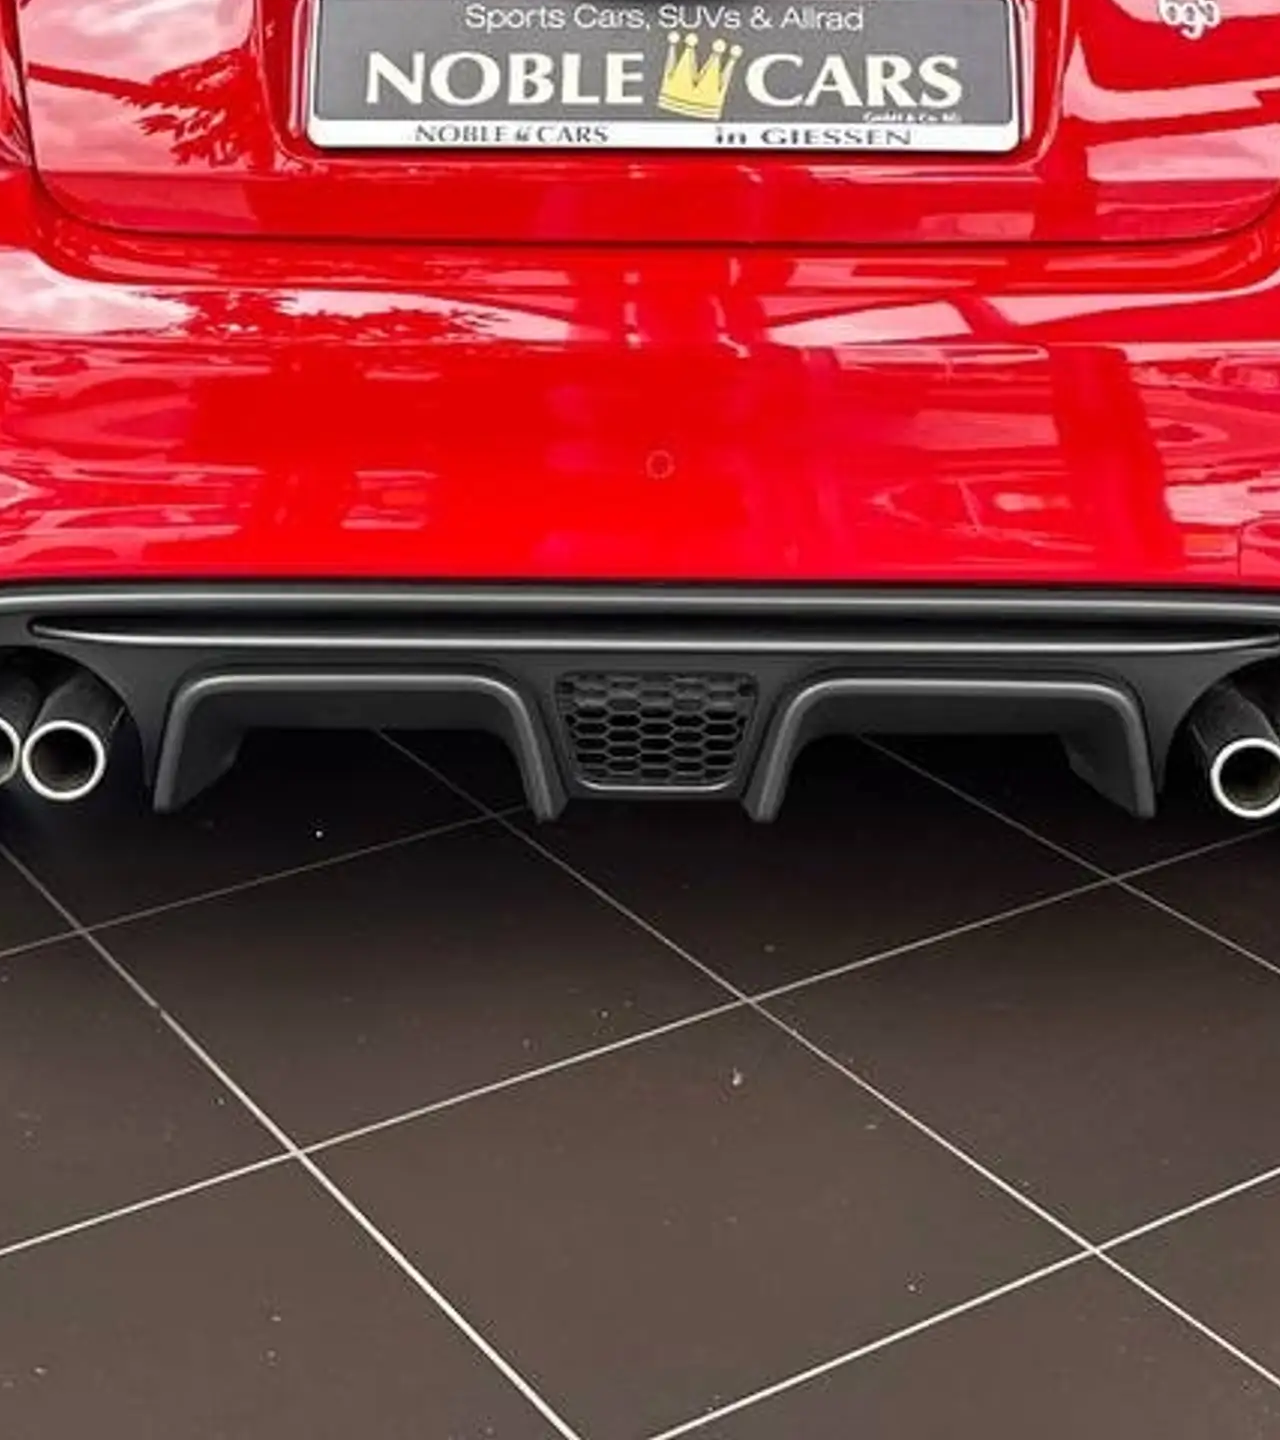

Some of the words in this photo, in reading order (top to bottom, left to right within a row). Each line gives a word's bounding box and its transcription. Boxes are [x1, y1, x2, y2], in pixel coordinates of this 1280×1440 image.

[465, 3, 566, 33] Sports
[574, 3, 651, 31] Cars,
[659, 3, 740, 30] SUVs
[750, 5, 772, 30] &
[780, 6, 865, 31] Allrad
[365, 50, 645, 107] NOBLE
[744, 52, 963, 110] CARS
[415, 124, 509, 143] NOBLE
[536, 124, 609, 144] CARS
[715, 126, 748, 145] in
[760, 127, 912, 146] GIESSEN
